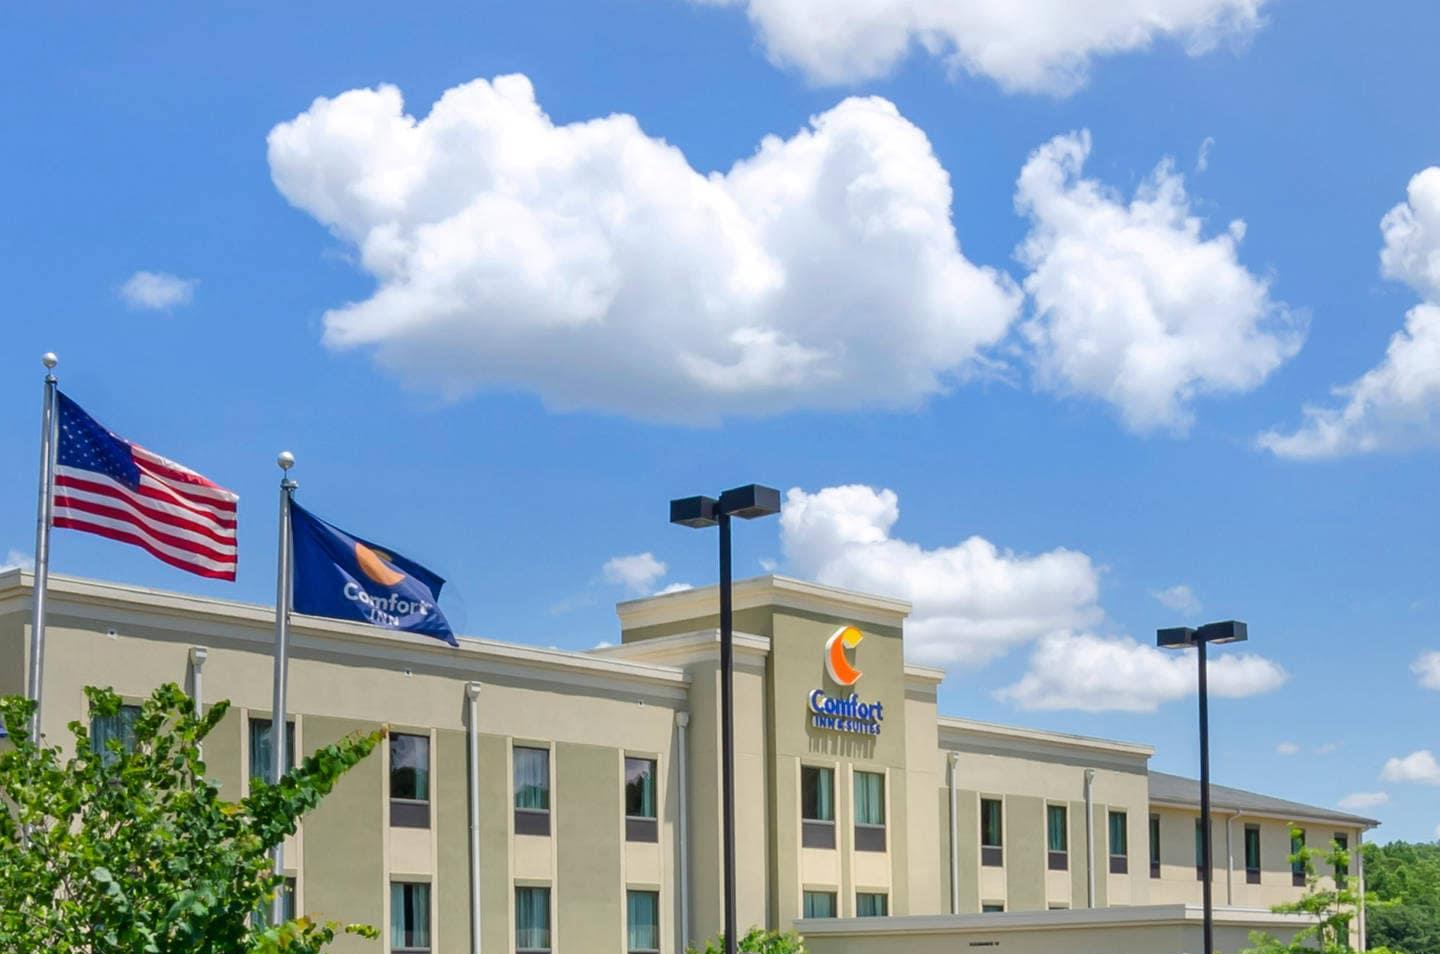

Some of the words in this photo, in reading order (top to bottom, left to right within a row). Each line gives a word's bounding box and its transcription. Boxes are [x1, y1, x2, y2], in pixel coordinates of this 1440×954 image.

[344, 582, 433, 615] Comfort
[369, 608, 399, 626] INN
[810, 688, 883, 721] Comfort
[813, 716, 834, 730] INN
